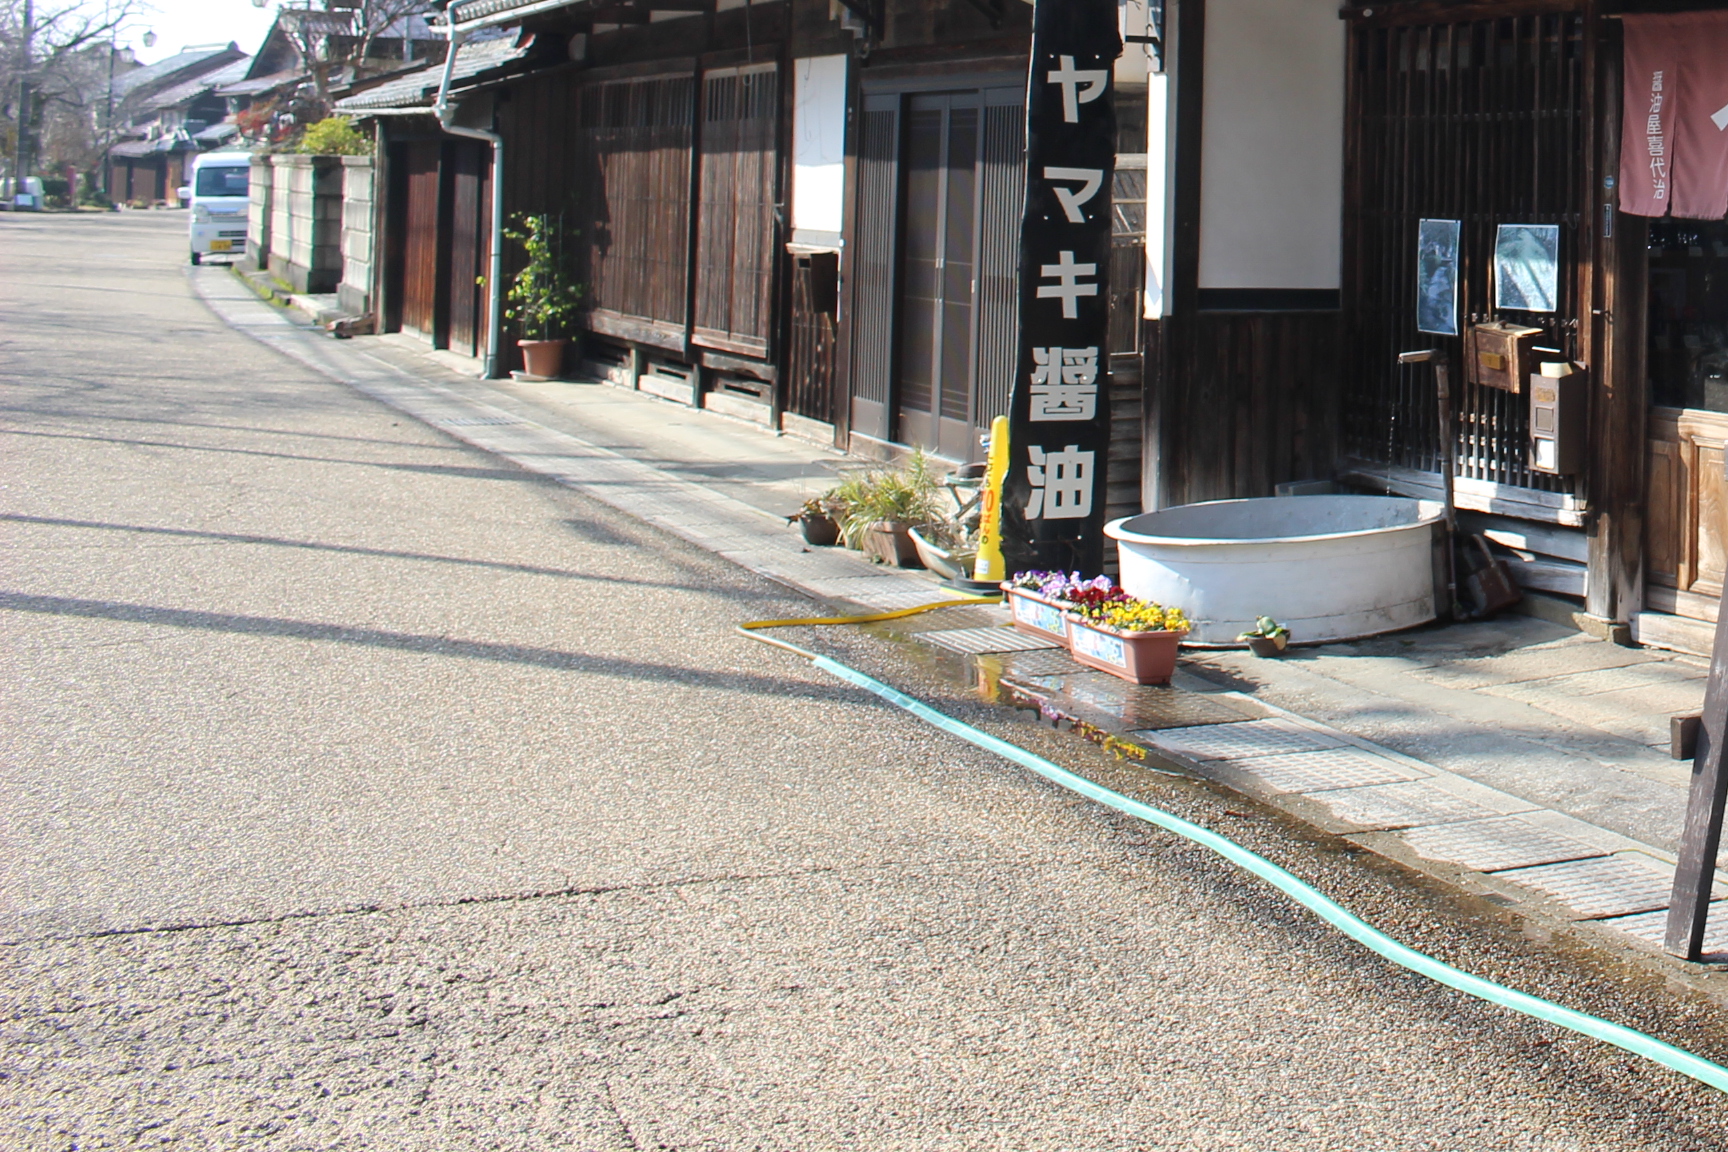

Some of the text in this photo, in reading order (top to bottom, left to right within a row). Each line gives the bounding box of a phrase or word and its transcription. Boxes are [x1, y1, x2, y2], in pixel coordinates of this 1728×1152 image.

[1024, 54, 1108, 521] ヤマキ醤油
